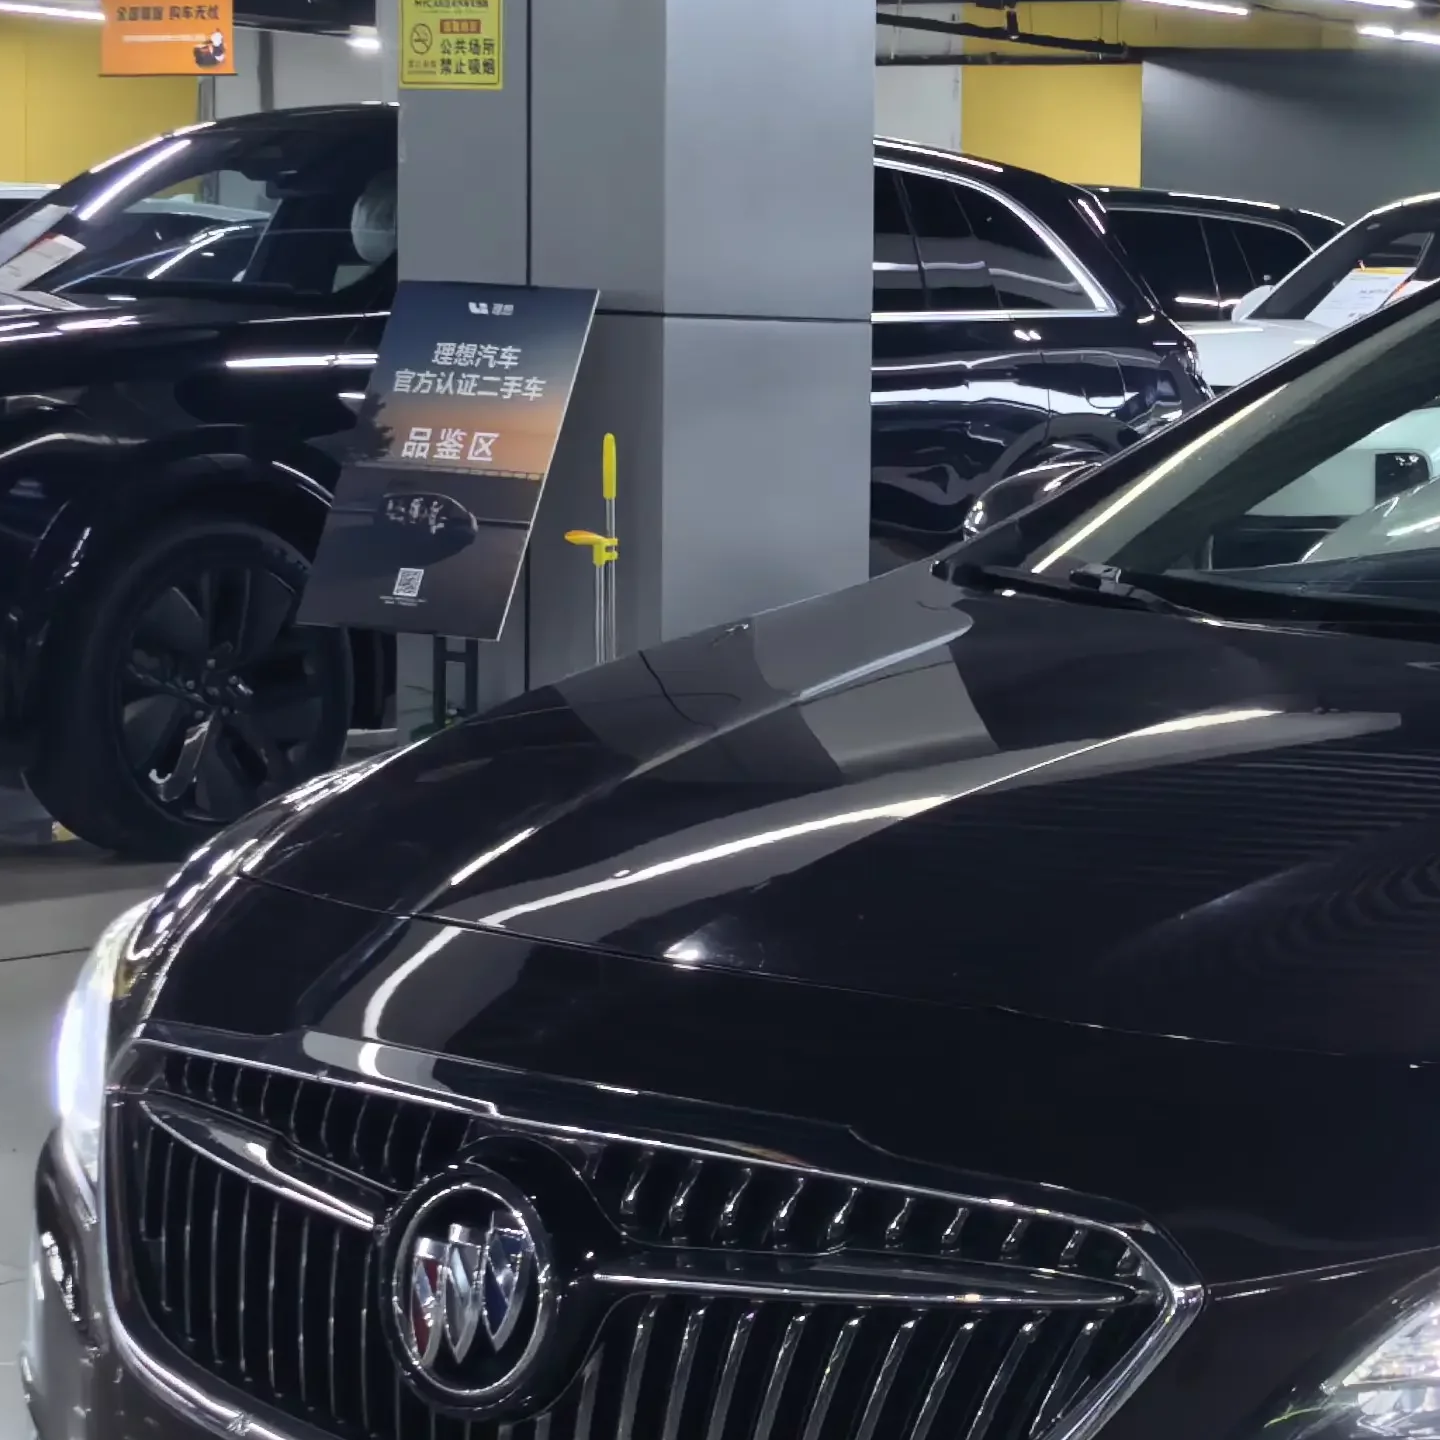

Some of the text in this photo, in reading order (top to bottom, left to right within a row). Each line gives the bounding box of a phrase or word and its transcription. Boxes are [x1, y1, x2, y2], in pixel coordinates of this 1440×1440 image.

[431, 342, 522, 369] 理想汽车
[393, 368, 547, 401] 官方认证二手车
[401, 426, 500, 462] 品鉴区
